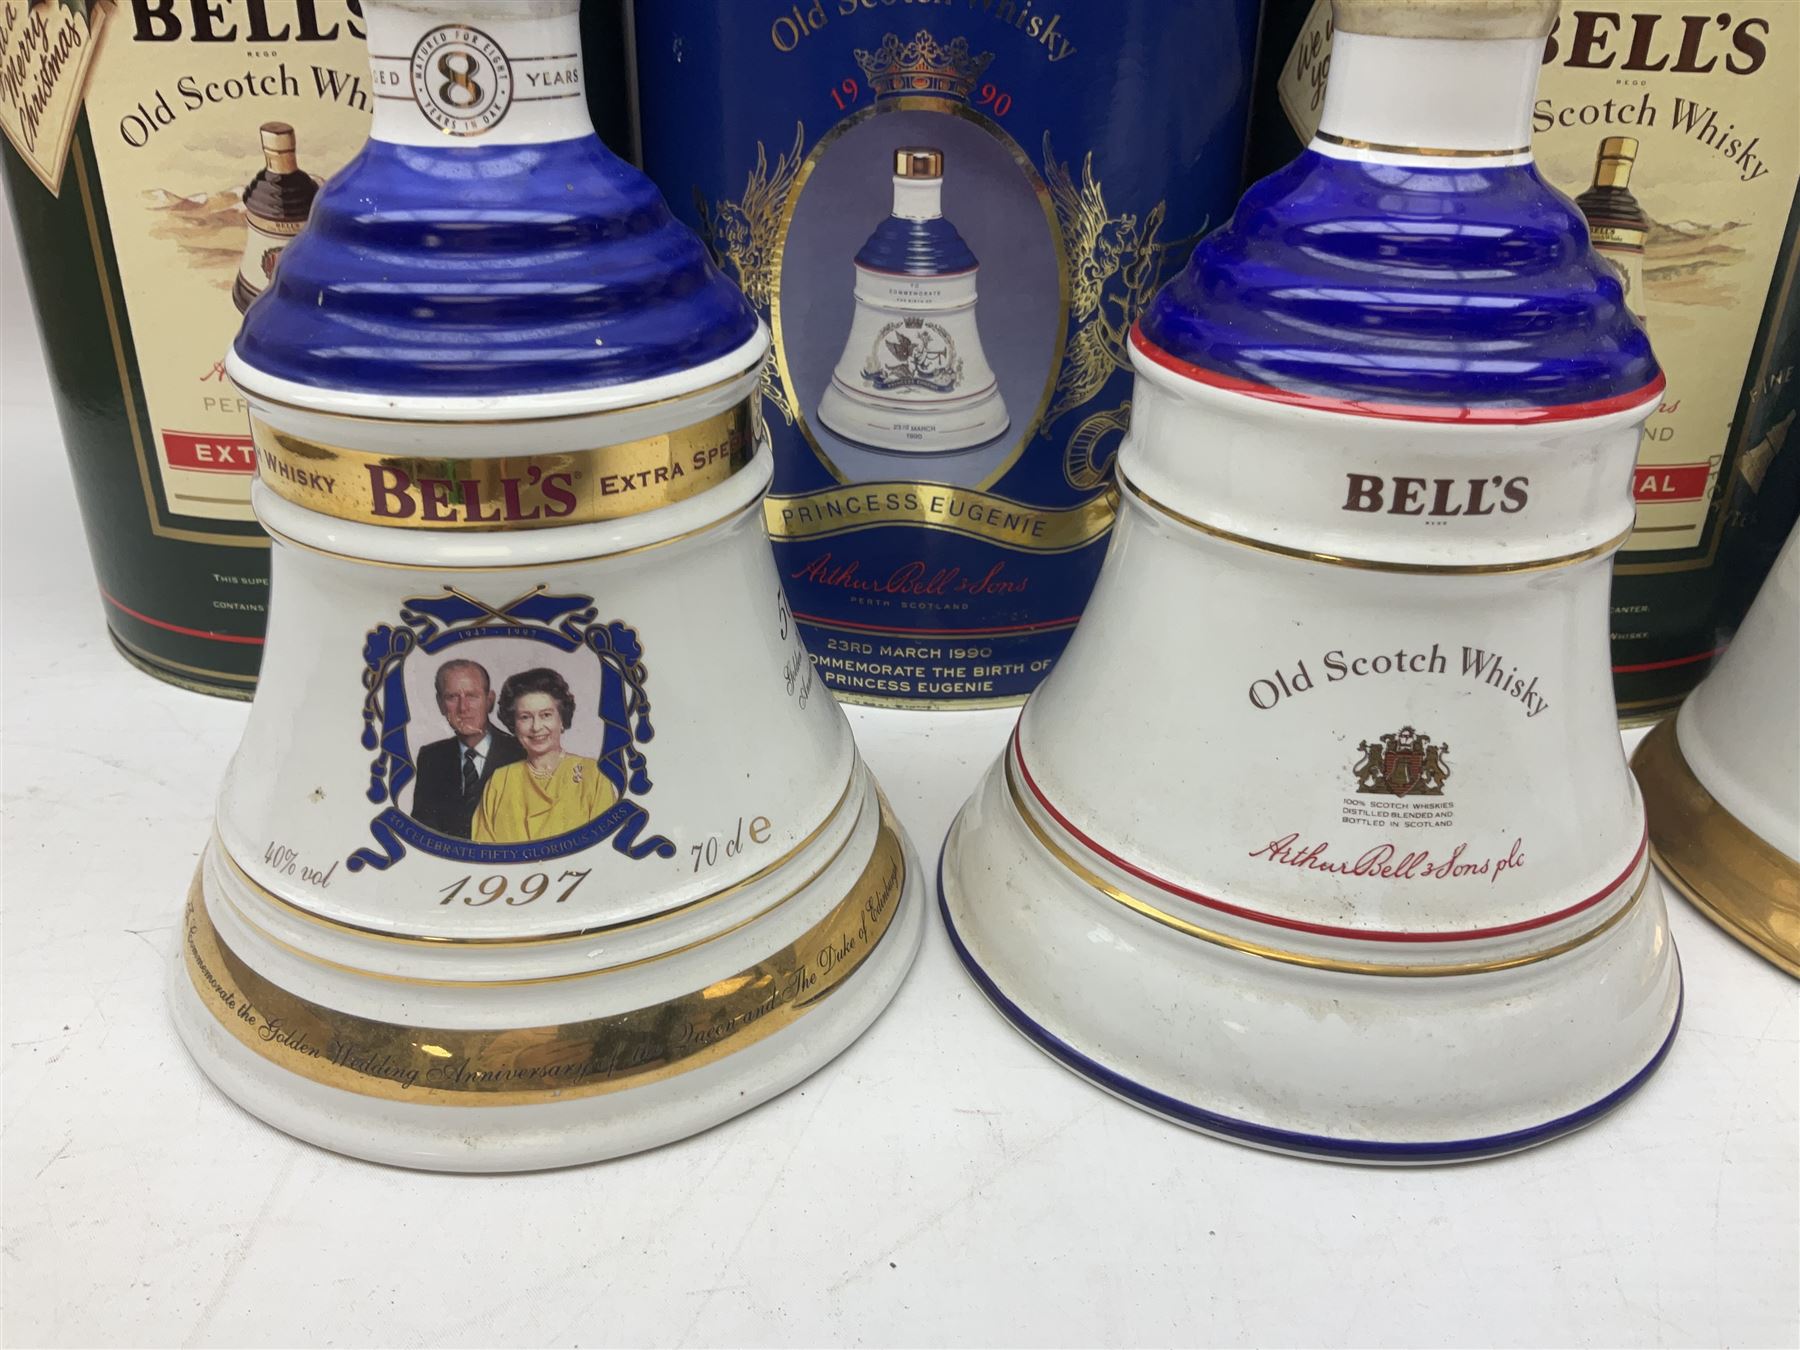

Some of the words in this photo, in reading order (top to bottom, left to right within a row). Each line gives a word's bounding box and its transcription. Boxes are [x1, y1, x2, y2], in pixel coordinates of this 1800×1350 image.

[771, 0, 829, 52] Old
[0, 11, 48, 109] Merry
[415, 33, 447, 79] MATURED
[455, 30, 478, 43] FOR
[483, 43, 507, 79] EIGHT
[19, 18, 81, 153] Christmas
[438, 51, 485, 109] 8
[526, 69, 578, 87] YEARS
[830, 78, 859, 111] 19
[977, 82, 1012, 117] 90
[120, 90, 176, 147] Old
[177, 63, 299, 112] Scotch
[310, 65, 373, 114] Wh
[425, 101, 456, 129] YEARS
[465, 121, 478, 130] IN
[482, 102, 501, 123] OAK
[1532, 93, 1657, 133] Scotch
[1672, 97, 1769, 182] Whisky
[264, 448, 336, 494] WHISKY
[364, 463, 579, 522] BELL'S
[600, 461, 684, 496] EXTRA
[1342, 472, 1529, 516] BELL'S
[783, 493, 919, 527] PRINCESS
[930, 496, 1047, 538] EUGENIE
[791, 552, 886, 592] Arthur
[886, 561, 961, 595] Bell
[967, 560, 1028, 594] Sons
[213, 600, 265, 611] CONTAINS
[850, 596, 890, 606] PERTH
[901, 602, 969, 610] SCOTLAND
[827, 638, 873, 655] 23RD
[880, 646, 941, 659] MARCH
[949, 648, 993, 659] 1990
[932, 667, 966, 678] THE
[973, 663, 1025, 678] BIRTH
[1030, 659, 1052, 672] OF
[825, 671, 911, 692] PRINCESS
[918, 681, 993, 693] EUGENIE
[1248, 659, 1314, 710] Old
[1323, 643, 1446, 682] Scotch
[1461, 646, 1549, 718] Whisky
[1342, 807, 1390, 818] DISTILLED
[1342, 816, 1385, 827] BOTTLED
[1404, 820, 1453, 828] SCOTLAND
[1343, 799, 1366, 807] 100%
[1370, 801, 1409, 809] SCOTCH
[404, 826, 476, 858] CELEBRATE
[480, 849, 519, 861] FIFTY
[523, 835, 590, 860] GLORIOUS
[592, 807, 628, 836] YEARS
[691, 836, 718, 873] 70
[726, 816, 744, 858] cl
[265, 841, 298, 875] 40%
[301, 860, 339, 888] vol
[1249, 832, 1352, 875] Arthur
[1350, 843, 1429, 880] Bell
[1434, 842, 1489, 880] Sons
[1491, 837, 1525, 883] plc
[439, 868, 592, 907] 1997
[237, 999, 256, 1026] the
[257, 1015, 321, 1060] Golden
[325, 1040, 420, 1089] Wedding
[426, 1055, 593, 1085] Anniversary
[743, 985, 780, 1023] and
[781, 963, 817, 1000] The
[816, 934, 856, 975] Duke
[858, 911, 870, 945] of
